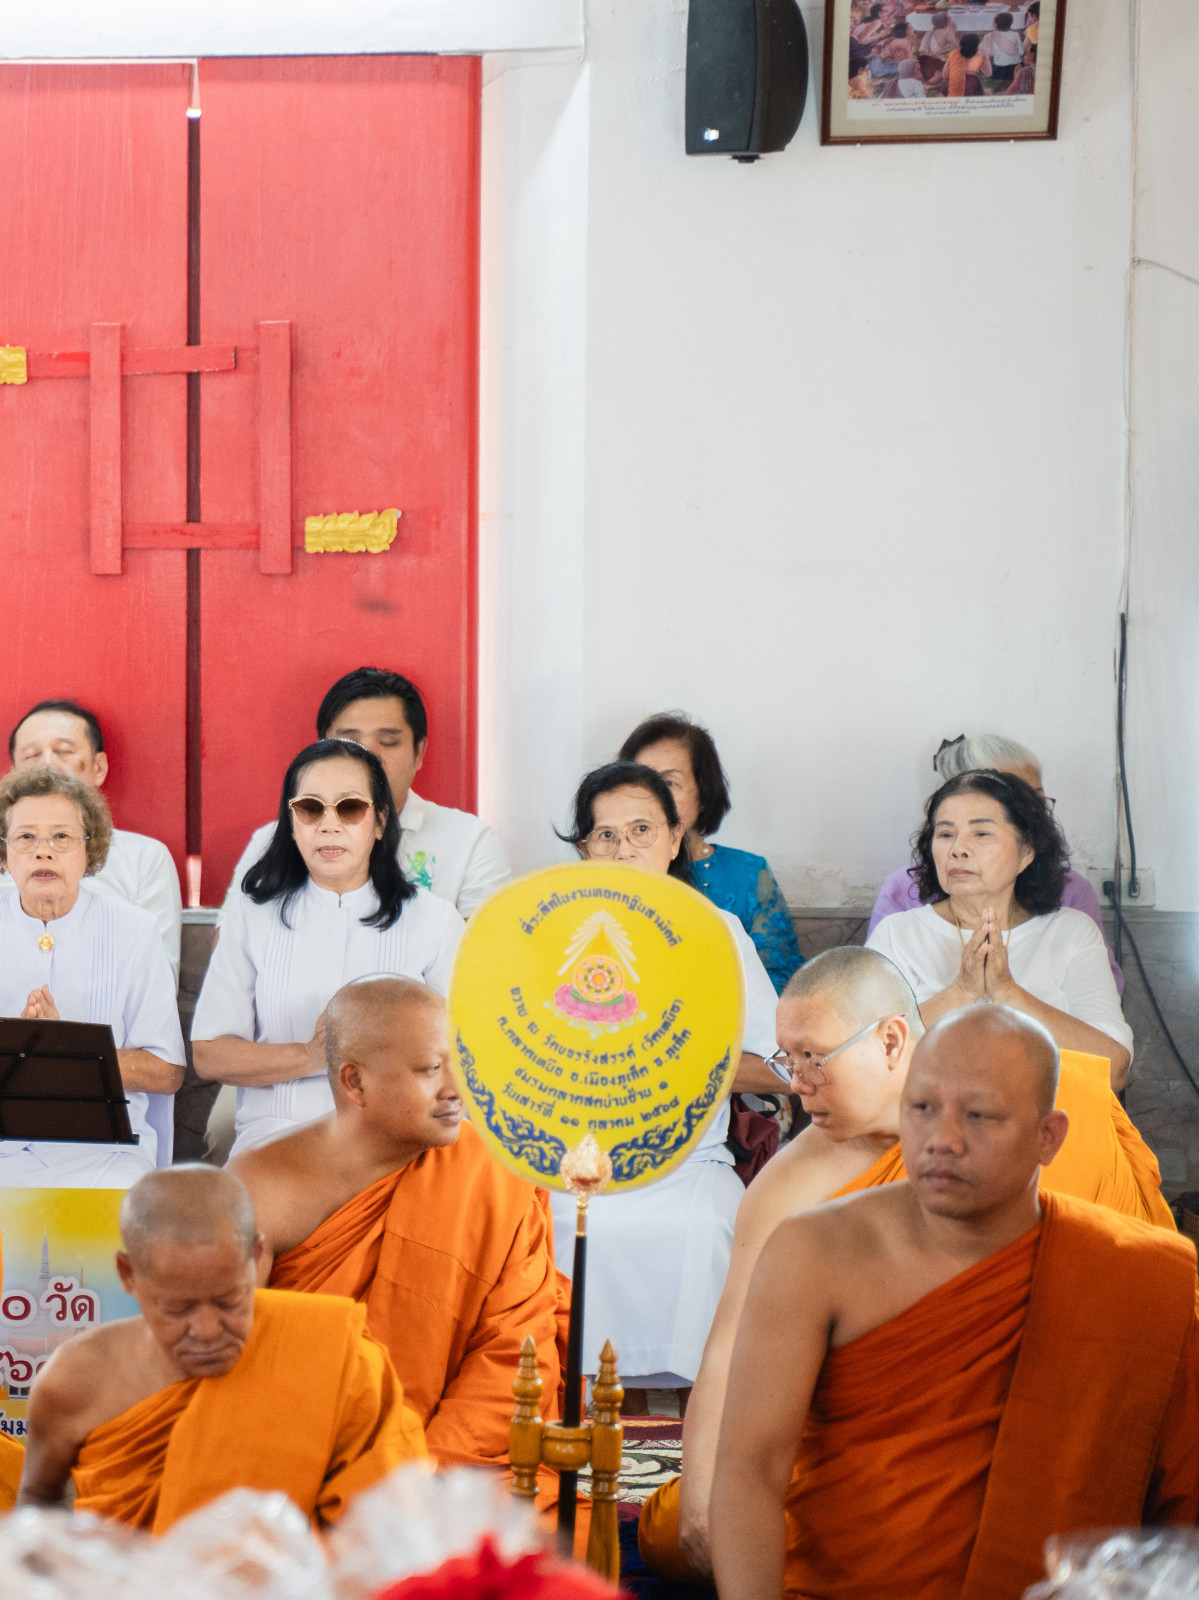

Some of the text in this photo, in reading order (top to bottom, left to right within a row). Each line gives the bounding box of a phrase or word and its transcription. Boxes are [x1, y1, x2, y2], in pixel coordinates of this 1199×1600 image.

[588, 1117, 634, 1134] ตุลาคม
[46, 1282, 95, 1322] วัด
